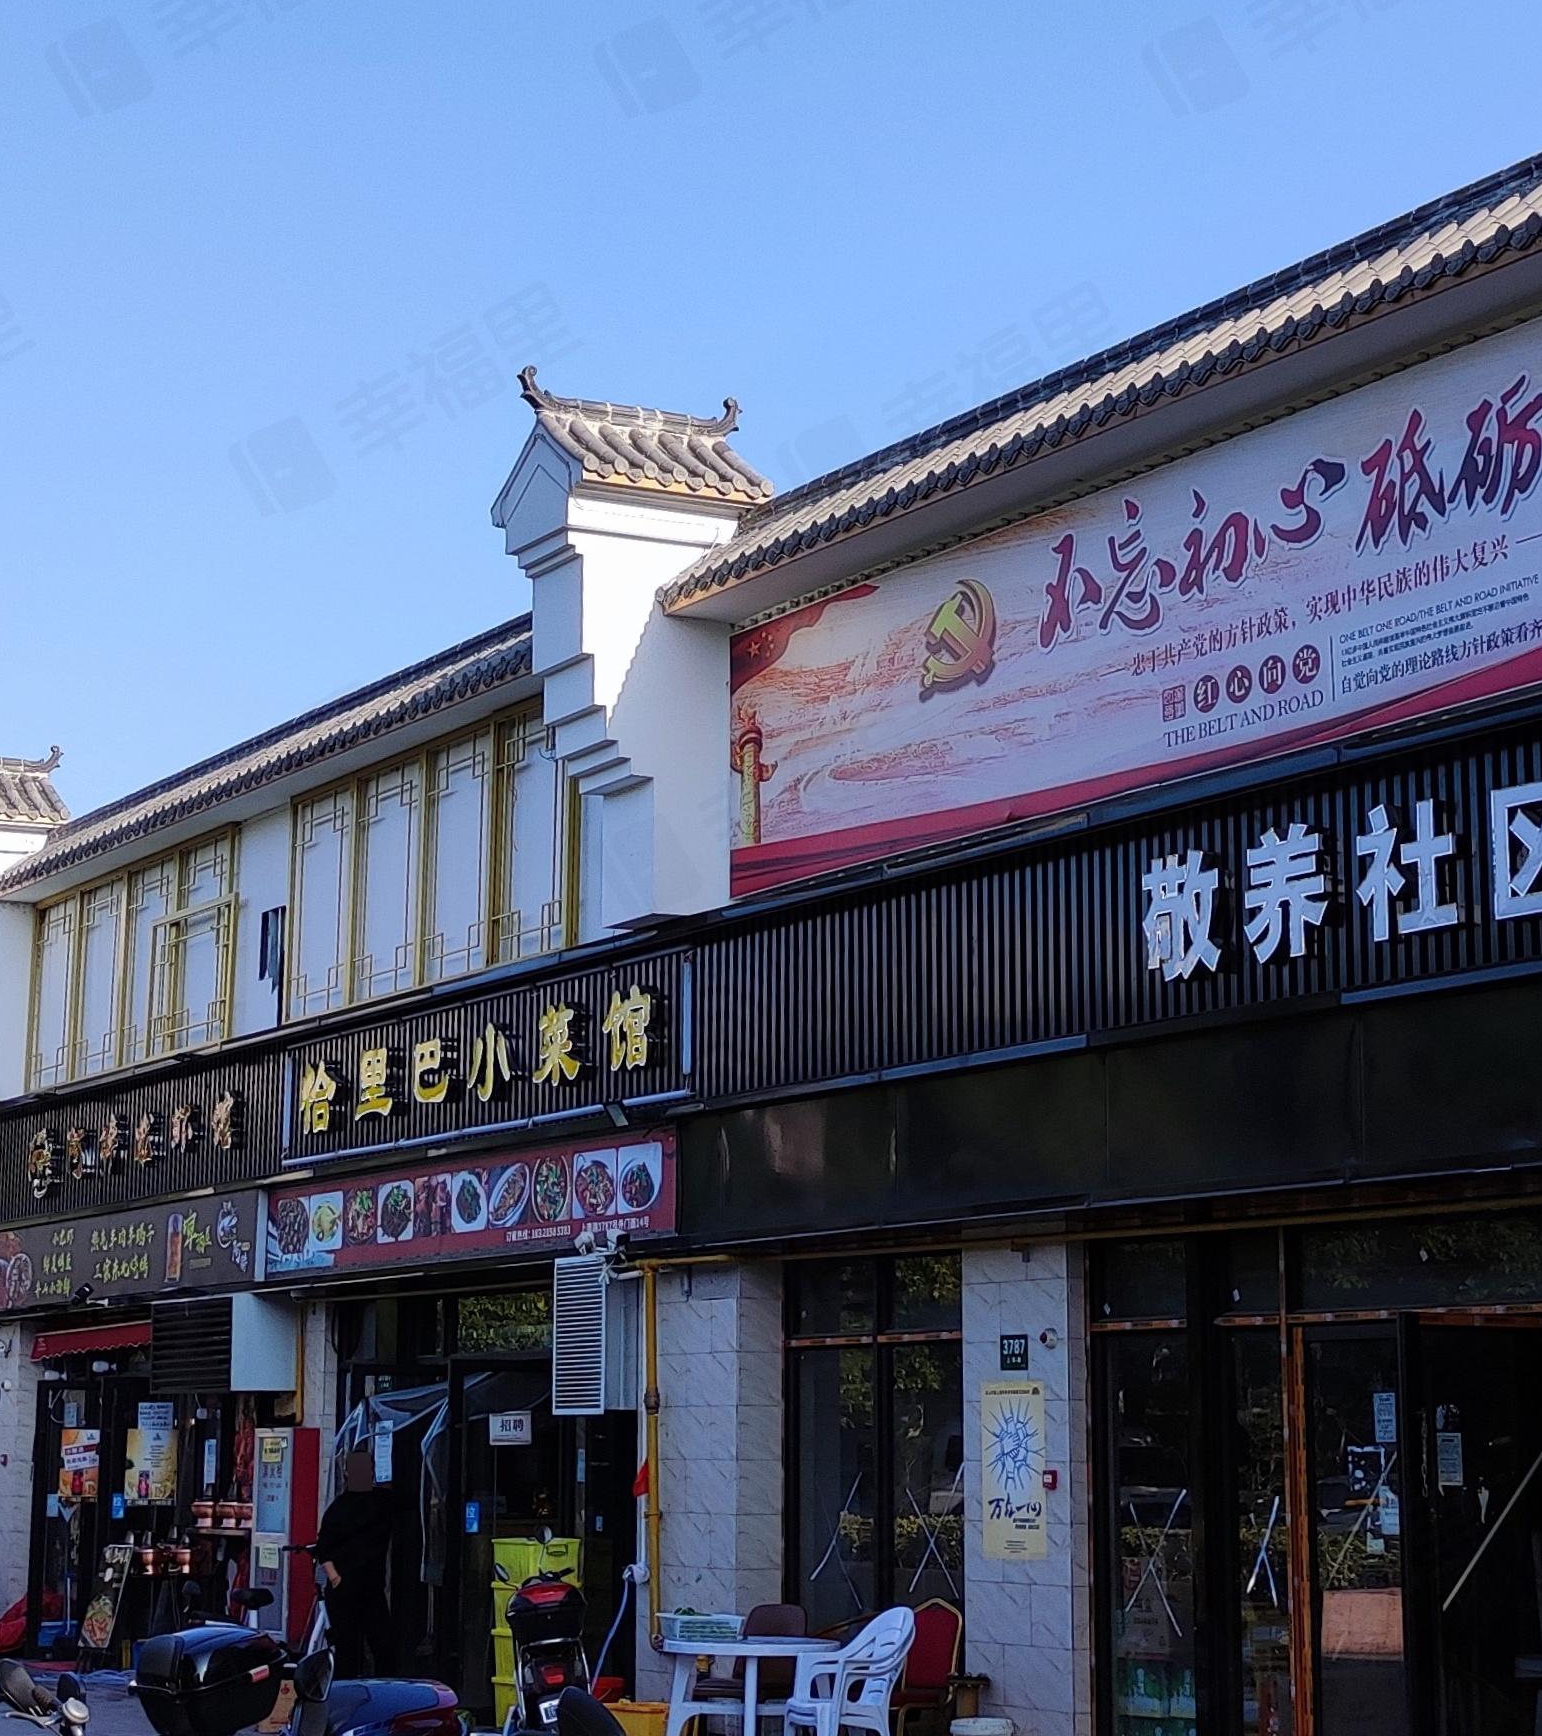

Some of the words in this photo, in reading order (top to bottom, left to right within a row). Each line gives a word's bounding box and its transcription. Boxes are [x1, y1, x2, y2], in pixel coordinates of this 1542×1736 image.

[1339, 630, 1357, 645] ONE
[1375, 620, 1394, 634] ONE
[1454, 594, 1473, 609] AND
[1474, 587, 1498, 602] ROAD
[1498, 573, 1540, 597] INITIATIVE
[1195, 646, 1321, 711] 红心向党
[1163, 725, 1196, 748] THE
[1198, 714, 1238, 739] BELT
[1240, 703, 1275, 728] AND
[1278, 689, 1324, 718] ROAD
[1002, 1339, 1026, 1355] 3787
[500, 1418, 524, 1432] 招聘
